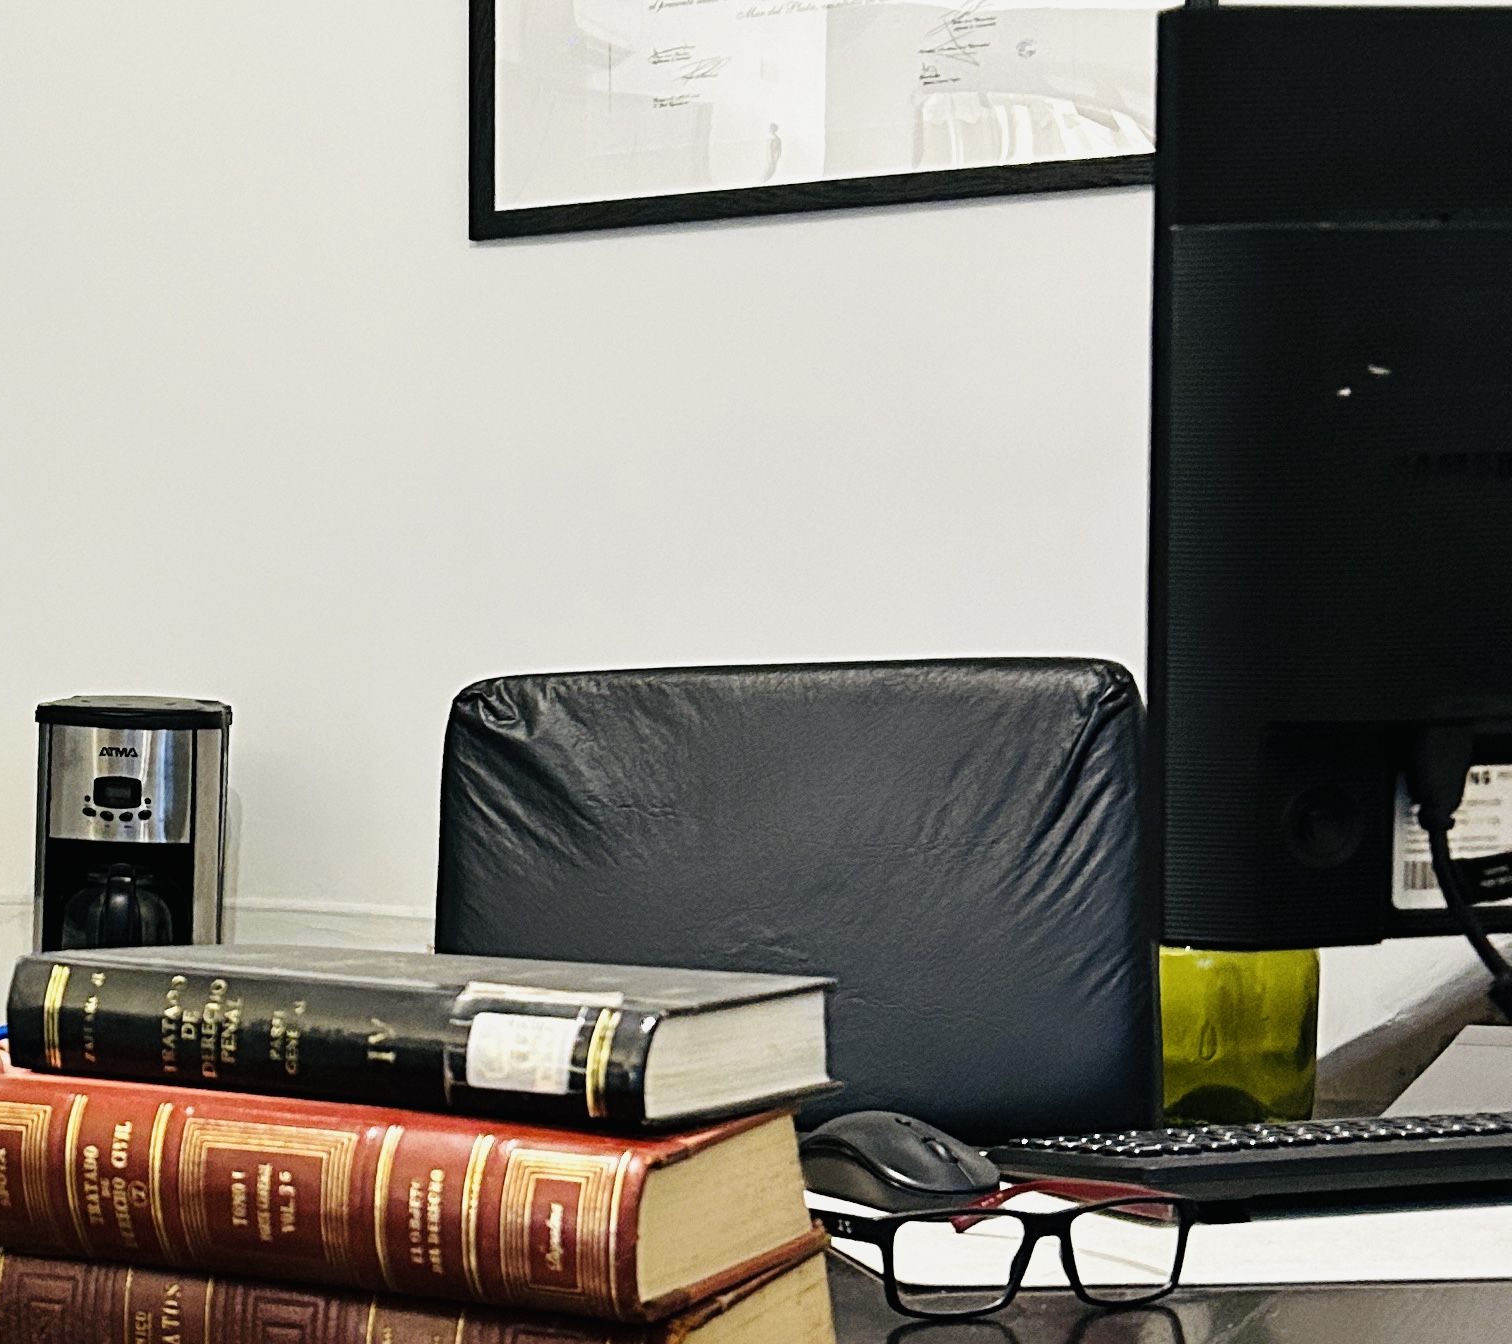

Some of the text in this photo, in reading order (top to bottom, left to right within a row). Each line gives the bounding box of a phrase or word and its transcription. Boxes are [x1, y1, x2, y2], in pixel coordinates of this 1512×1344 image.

[97, 745, 140, 758] ATMA
[160, 973, 188, 1074] TRATADO
[180, 1008, 202, 1041] DE
[200, 978, 230, 1080] DERECHO
[220, 997, 243, 1065] PENAL
[366, 1017, 398, 1065] IV
[110, 1119, 134, 1170] CIVIL
[82, 1143, 106, 1227] TRATADO
[230, 1181, 249, 1227] TOMO
[426, 1168, 446, 1245] DERECHO
